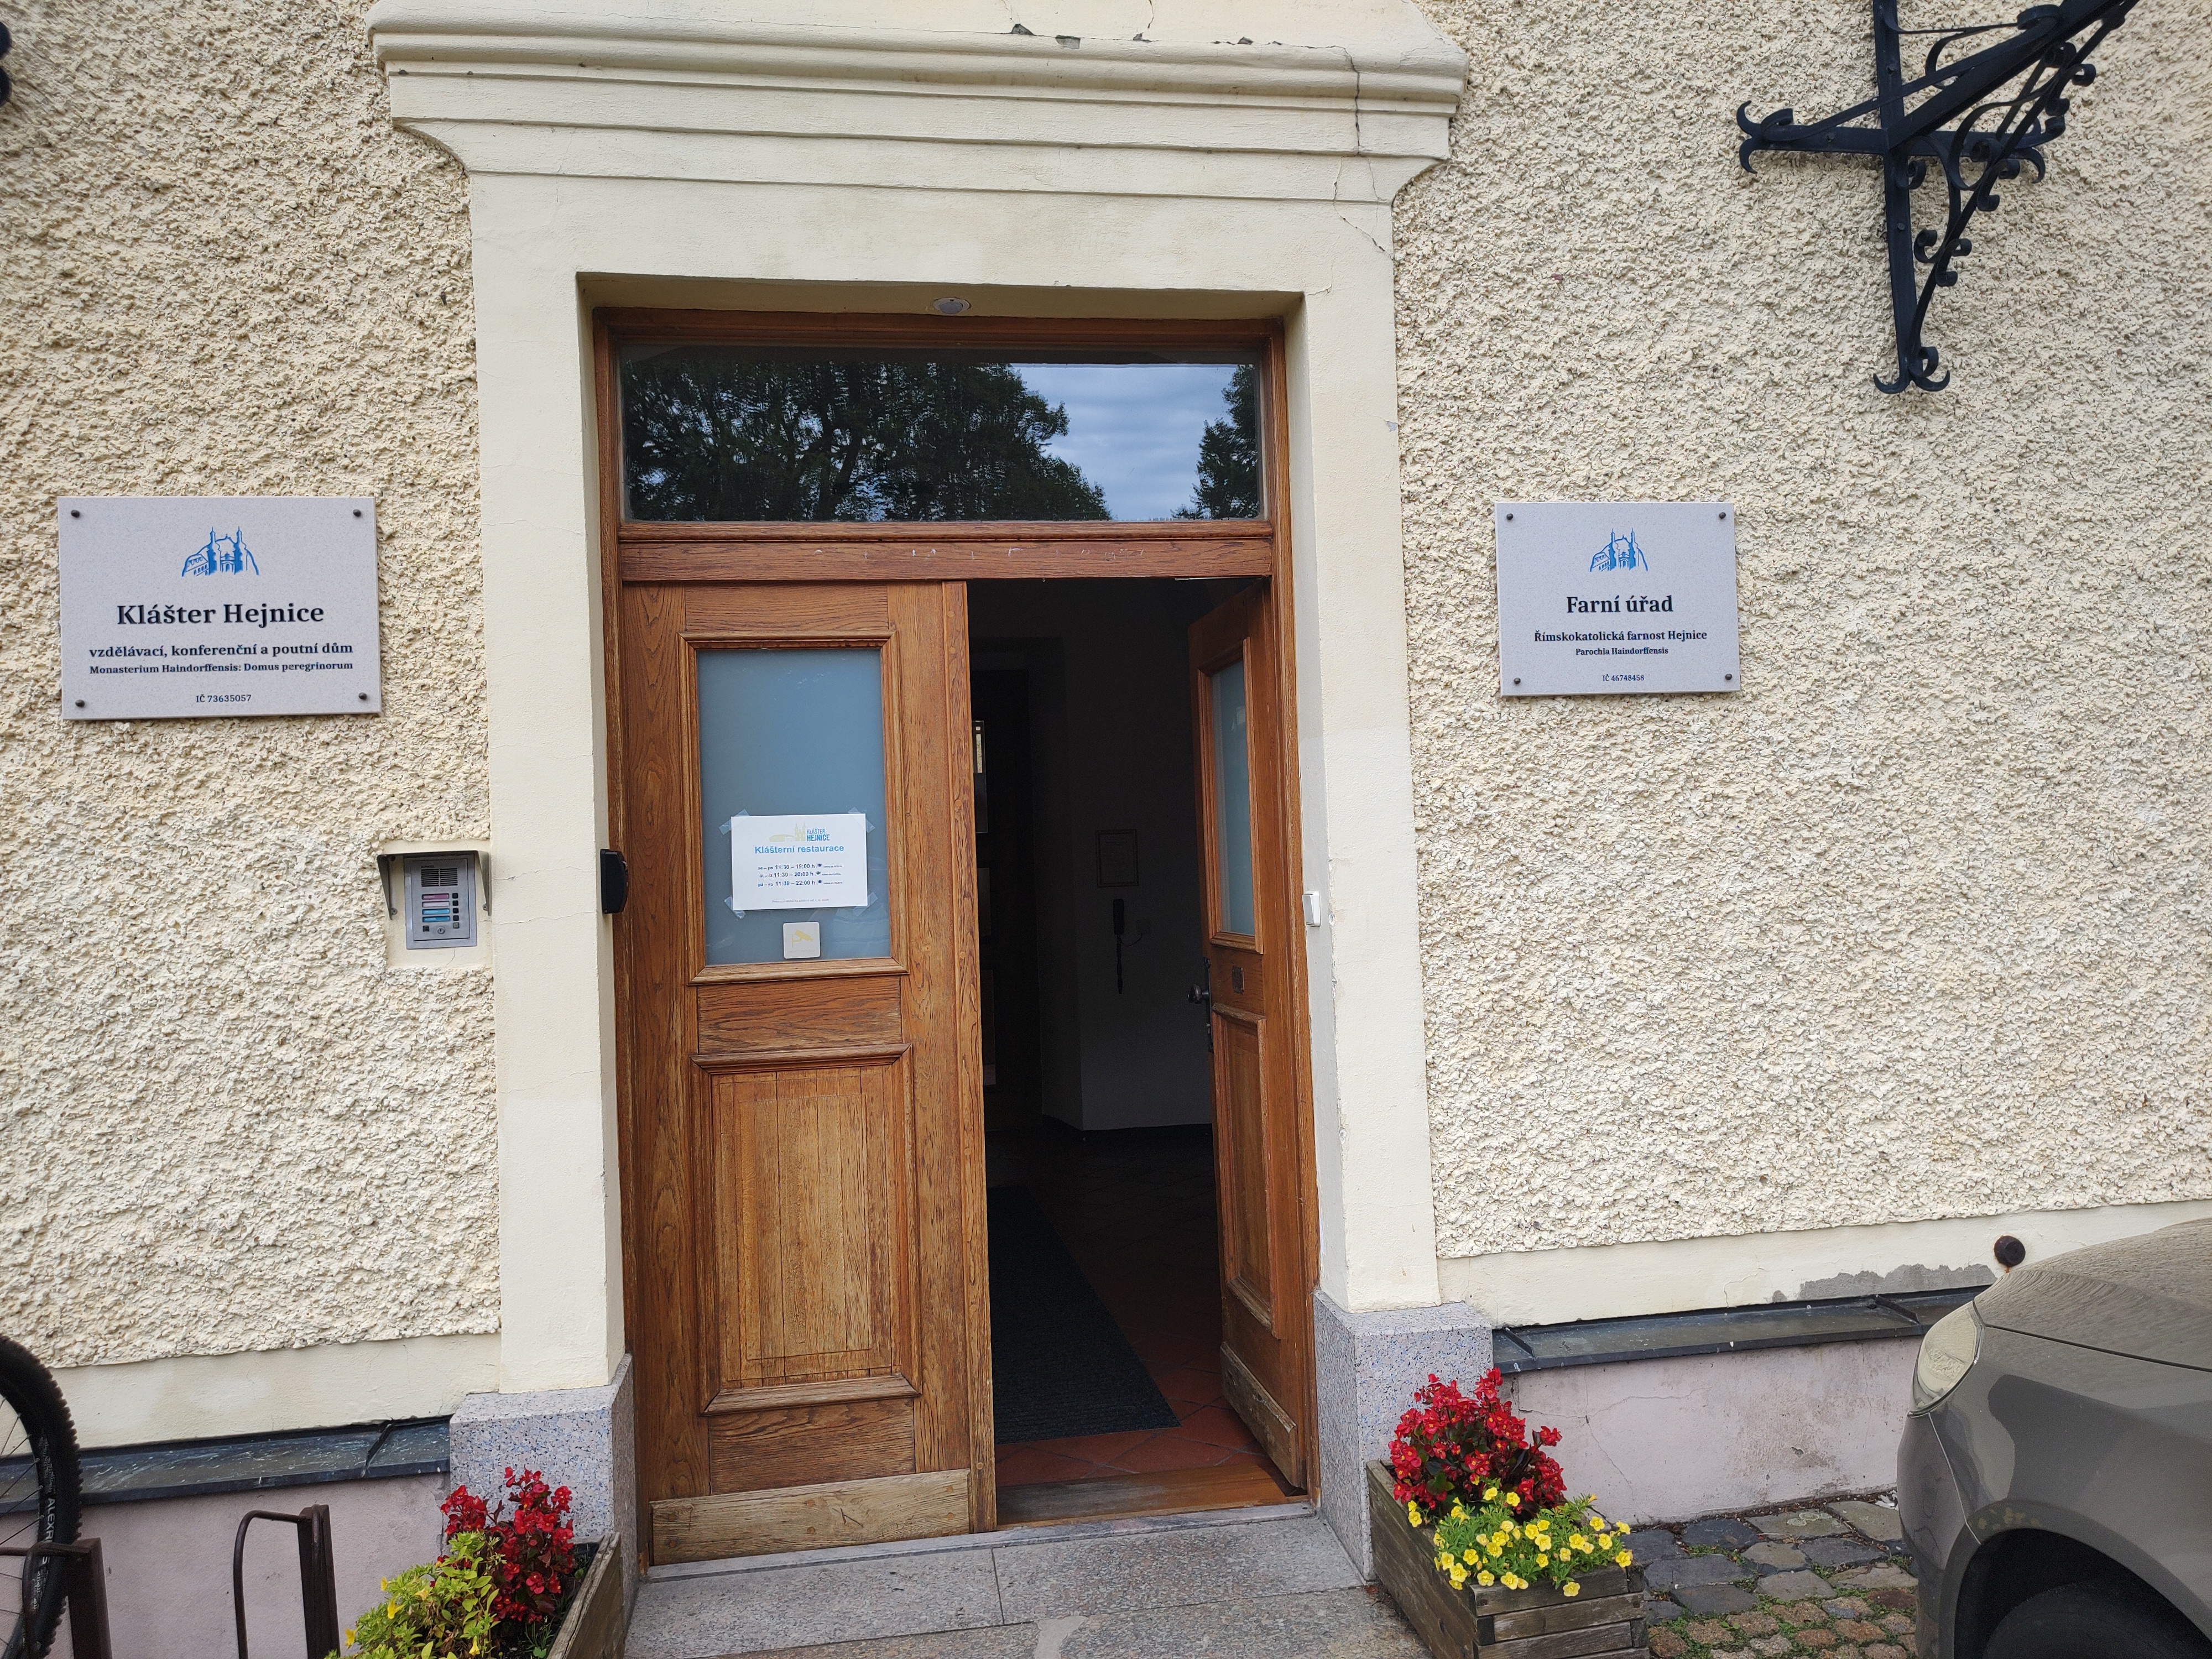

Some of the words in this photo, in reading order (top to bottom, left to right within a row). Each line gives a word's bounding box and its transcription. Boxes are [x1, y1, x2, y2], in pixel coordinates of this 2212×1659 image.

[1566, 594, 1621, 613] Farní
[1625, 594, 1674, 613] úřad
[117, 603, 217, 625] Klášter
[223, 603, 324, 629] Hejnice
[1534, 630, 1625, 642] Římskokatolická
[1626, 630, 1666, 640] farnost
[1667, 629, 1708, 642] Hejnice
[88, 644, 168, 658] vzdělávací,
[171, 643, 257, 656] konferenční
[260, 646, 269, 655] a
[272, 643, 319, 658] poutní
[322, 642, 353, 654] dům
[1575, 647, 1610, 655] Parochia
[1611, 646, 1668, 655] Haindorffensis
[90, 665, 160, 674] Monasterium
[161, 663, 242, 673] Haindorffensis:
[243, 663, 279, 671] Domus
[281, 661, 353, 672] peregrinorum
[1602, 674, 1610, 682] IČ
[196, 693, 206, 703] IČ
[207, 694, 252, 703] 73635057
[755, 846, 795, 854] Klášterní
[42, 1498, 56, 1565] ALEXRIS
